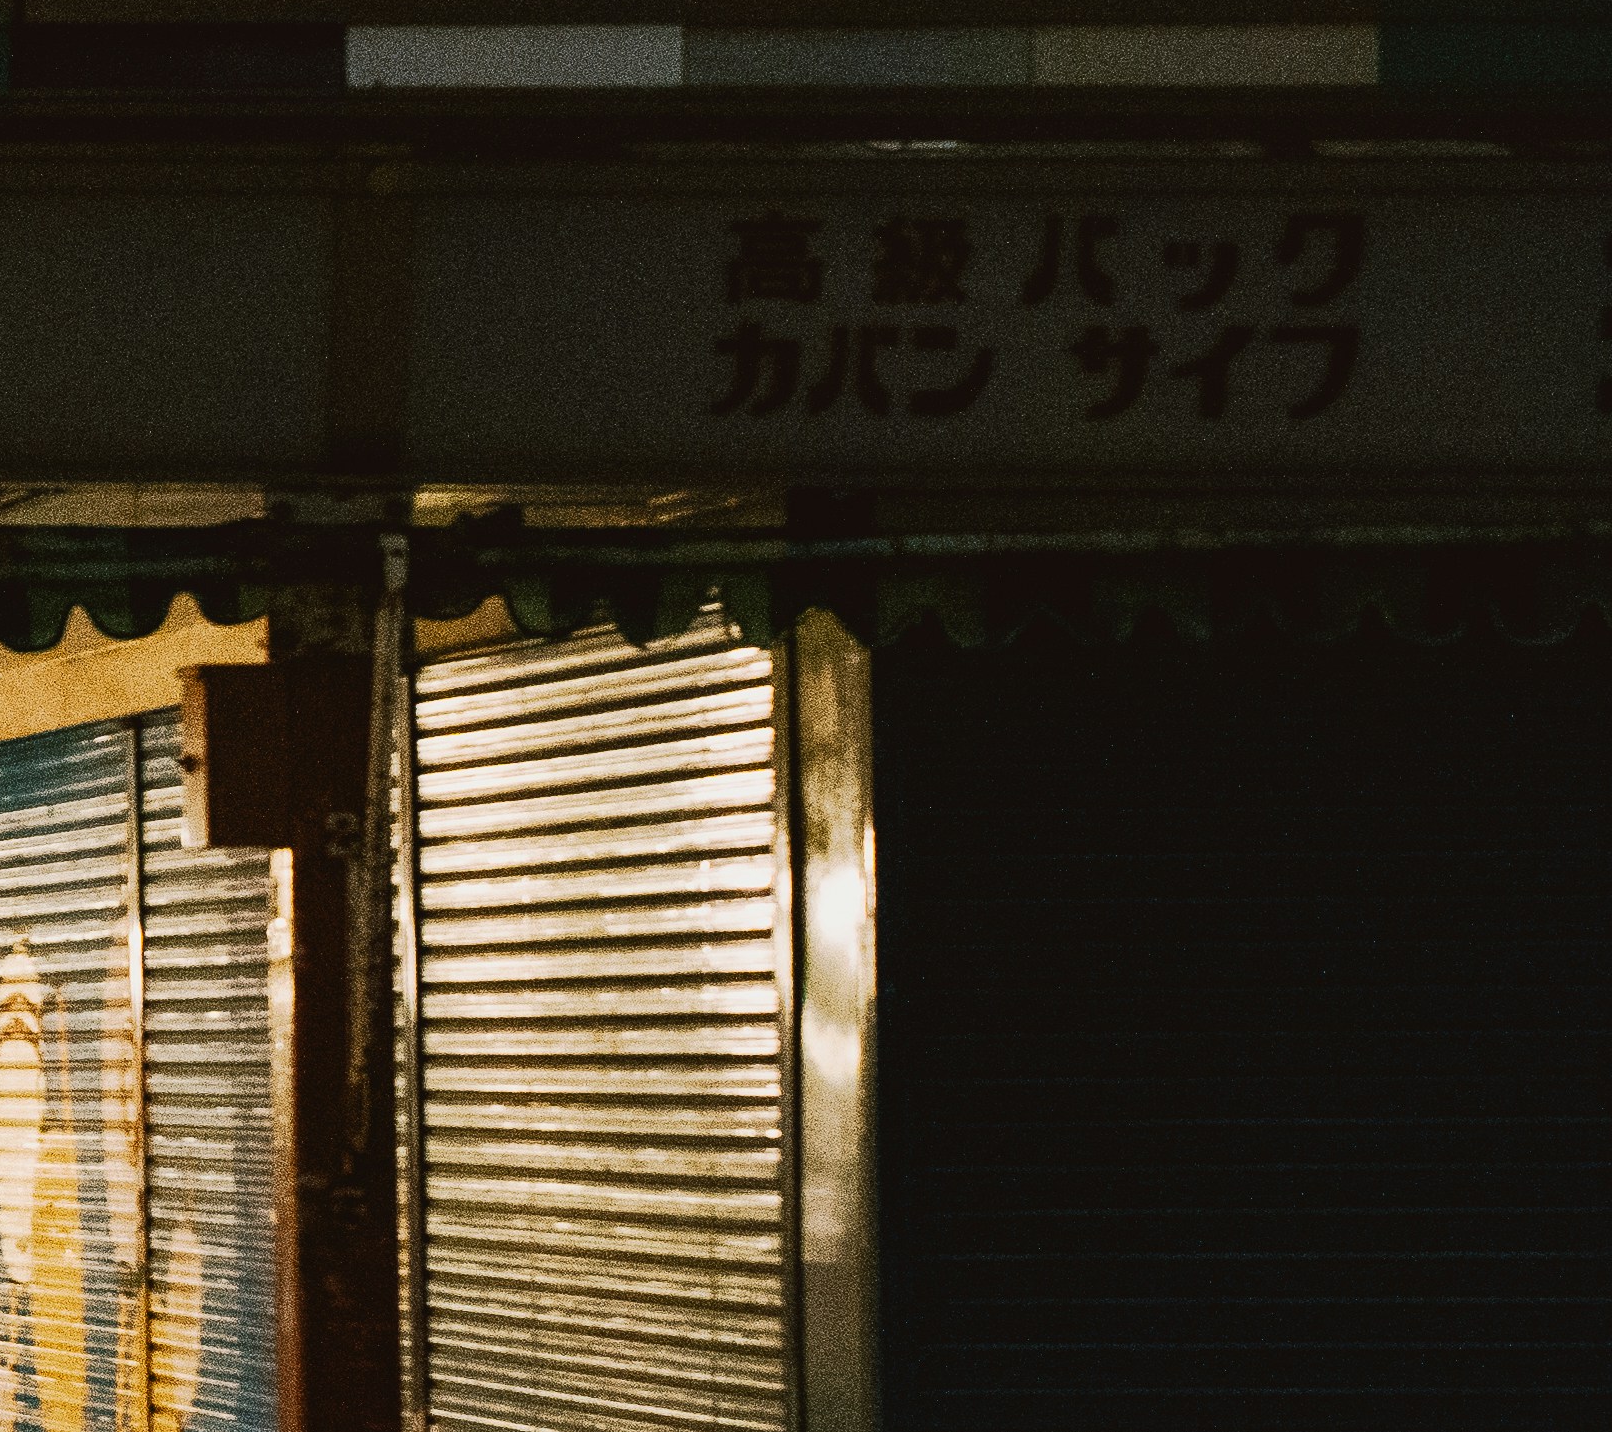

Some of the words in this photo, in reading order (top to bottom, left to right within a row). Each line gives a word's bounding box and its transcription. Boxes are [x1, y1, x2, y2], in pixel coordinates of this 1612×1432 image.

[724, 211, 972, 305] 高級
[709, 322, 996, 418] カバン
[1070, 324, 1360, 420] サイフ
